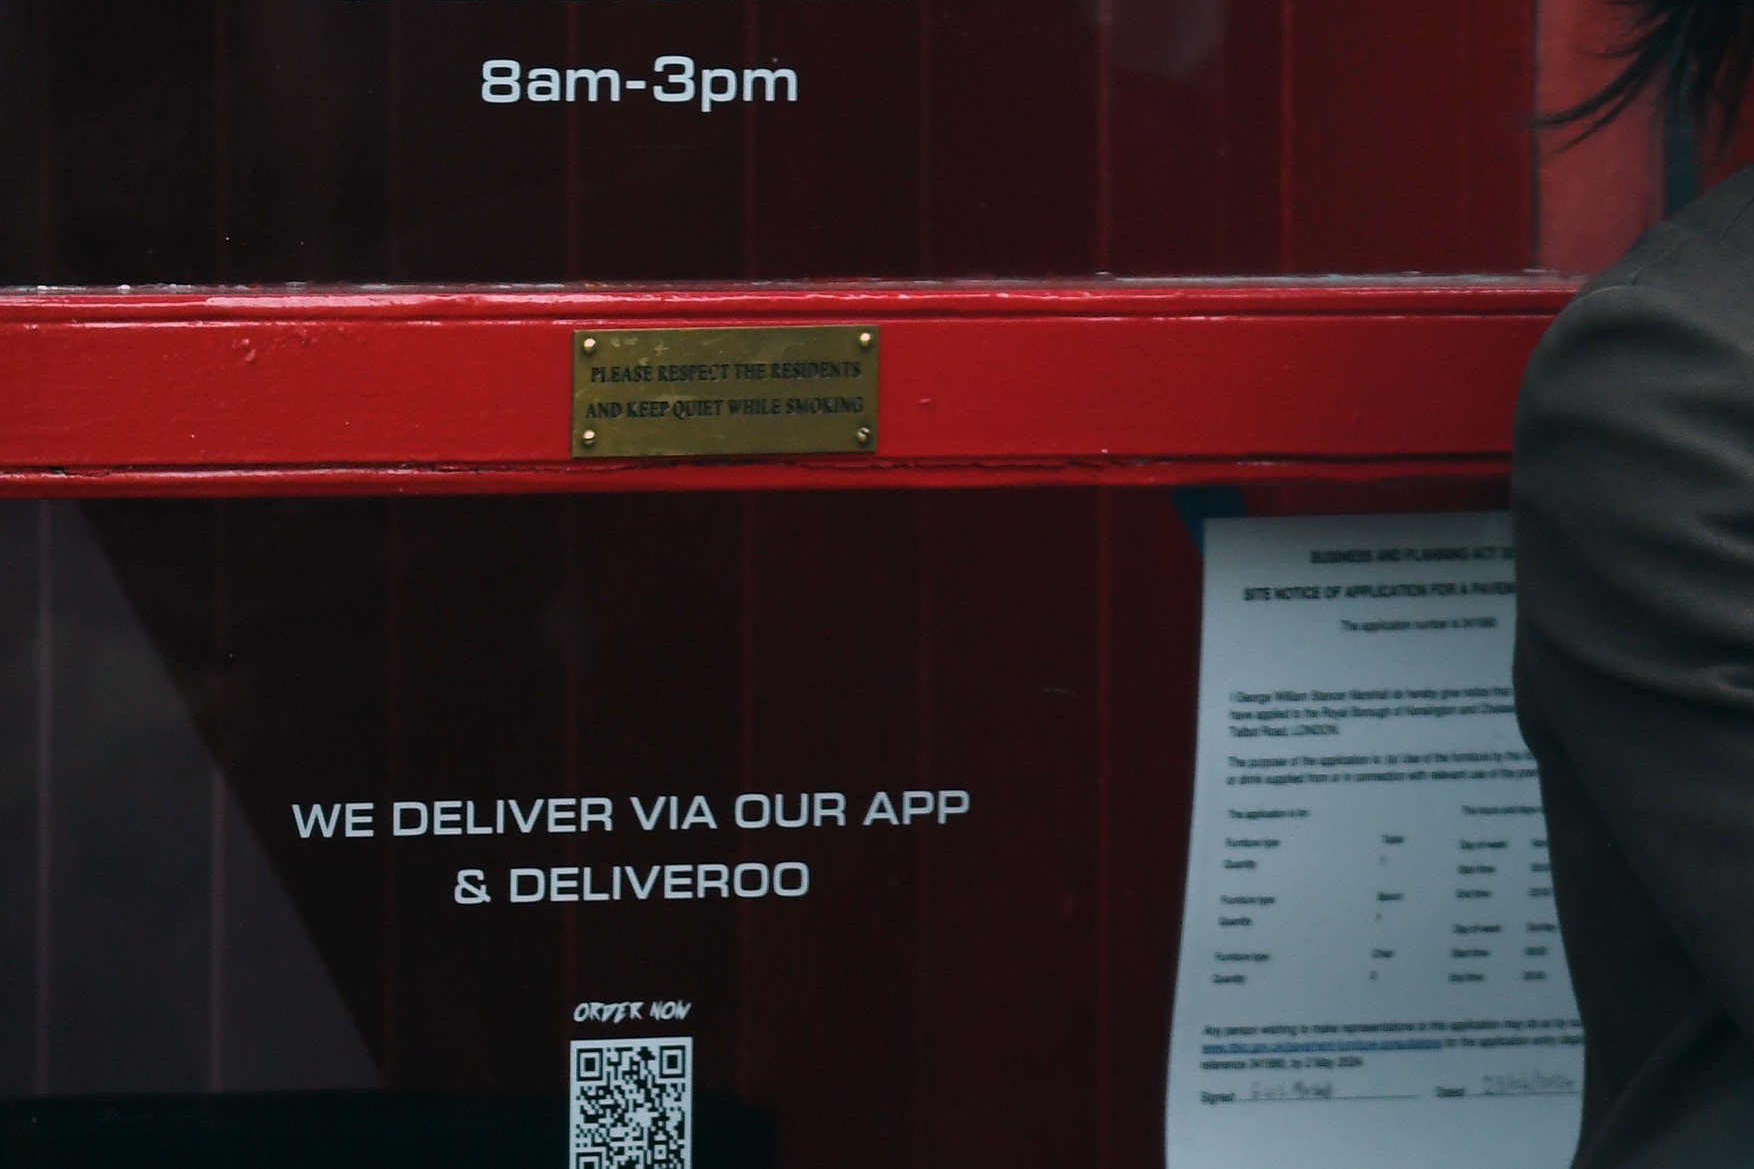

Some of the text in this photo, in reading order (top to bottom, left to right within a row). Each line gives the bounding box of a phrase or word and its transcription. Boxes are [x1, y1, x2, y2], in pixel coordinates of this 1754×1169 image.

[483, 57, 797, 113] 8am-3pm
[591, 361, 860, 383] PLEASE RESPECT THE RESIDENTS
[586, 397, 863, 420] AND KEEP QUIET WHILE SMOKING
[1244, 587, 1271, 601] SITE
[1274, 586, 1321, 600] NOTICE
[1344, 584, 1426, 598] APPLICATION
[293, 792, 969, 839] WE DELIVER VIA OUR APP
[456, 863, 809, 905] & DELIVEROO
[575, 1002, 691, 1024] ORDER NOW
